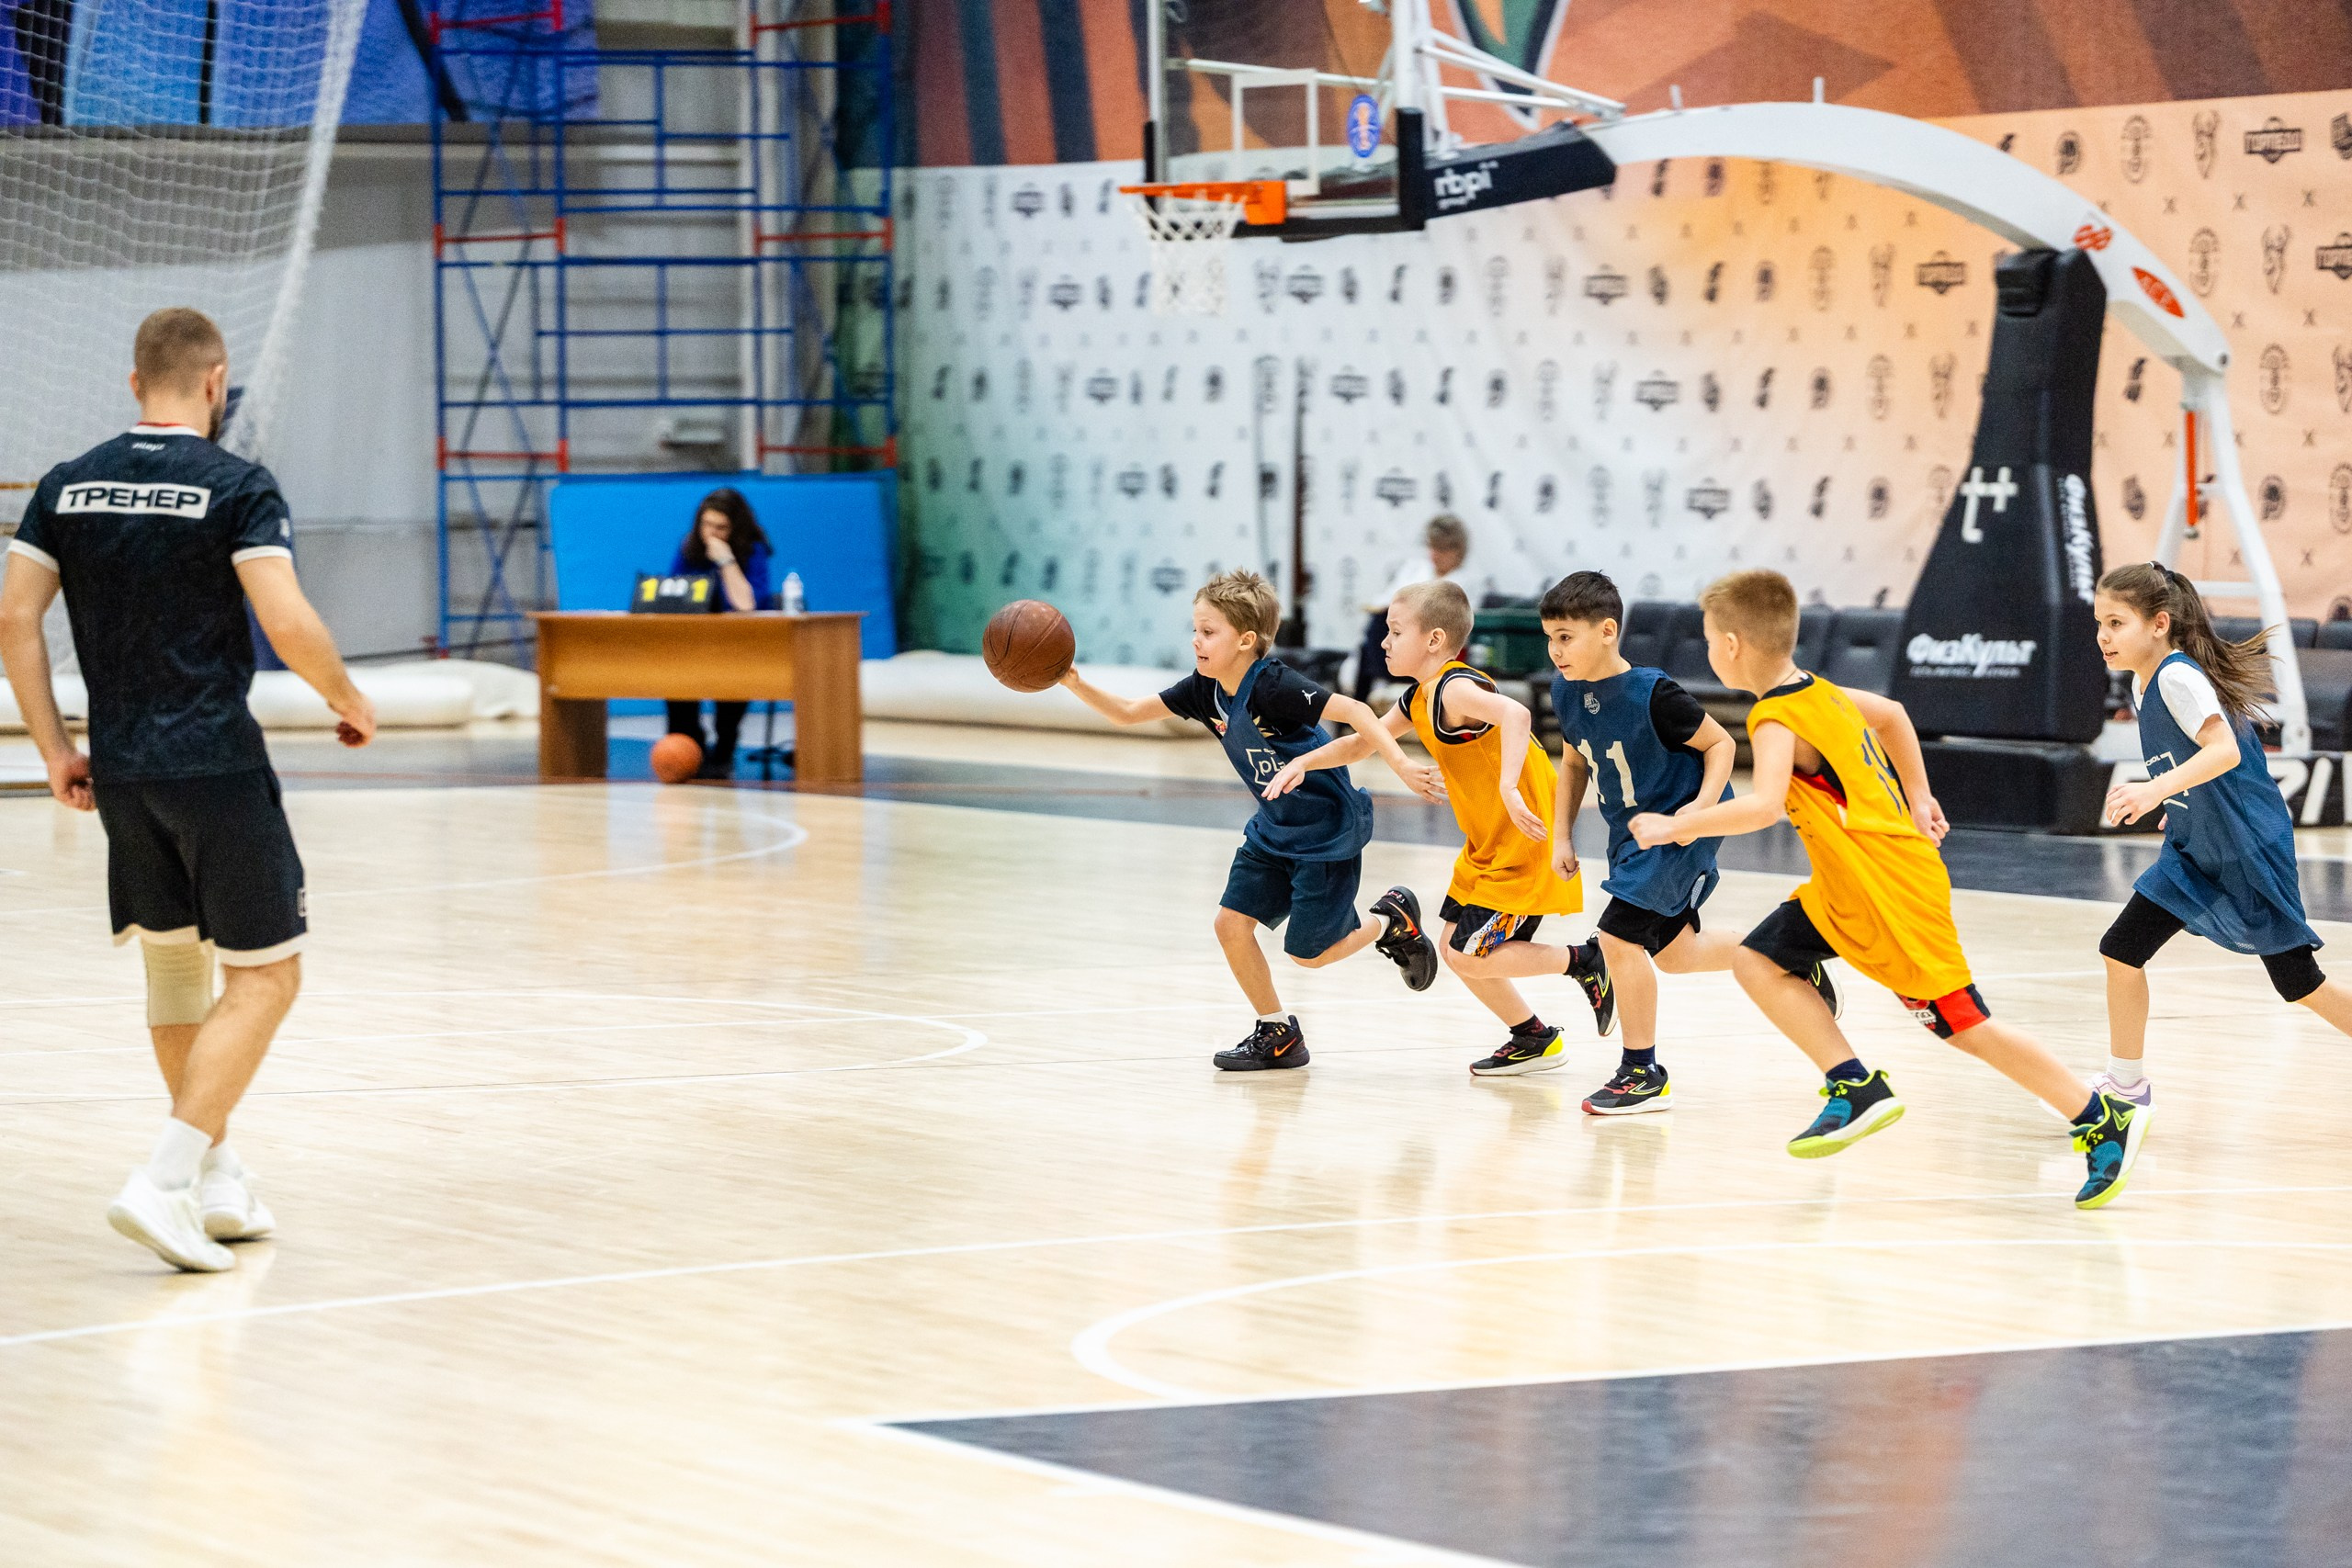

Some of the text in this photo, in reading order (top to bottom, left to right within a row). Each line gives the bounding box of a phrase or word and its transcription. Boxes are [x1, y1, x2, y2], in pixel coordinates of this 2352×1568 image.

[68, 487, 202, 509] ТРЕНЕР
[641, 578, 658, 602] 1
[691, 578, 708, 603] 1
[1906, 633, 2037, 678] ФизКульт
[1577, 739, 1638, 808] 11
